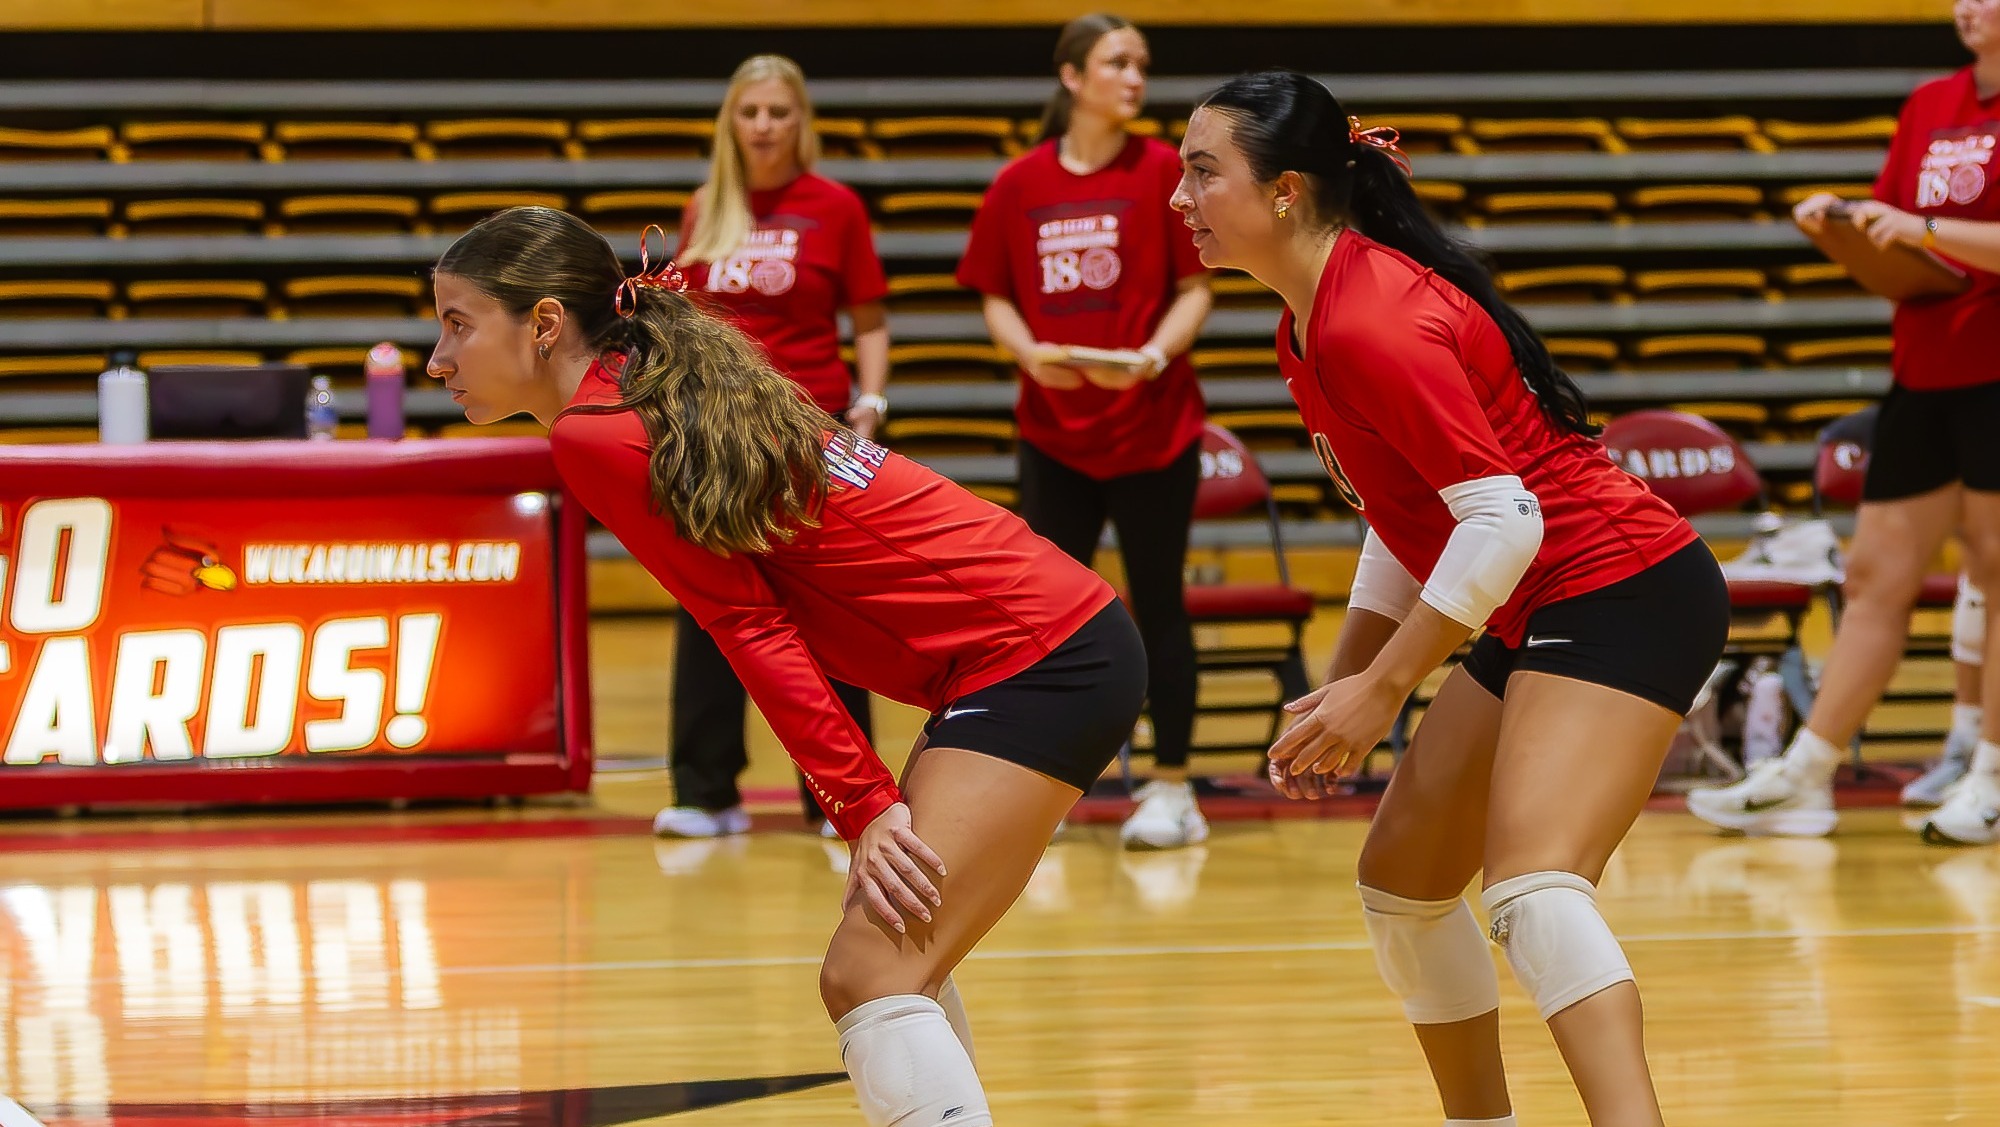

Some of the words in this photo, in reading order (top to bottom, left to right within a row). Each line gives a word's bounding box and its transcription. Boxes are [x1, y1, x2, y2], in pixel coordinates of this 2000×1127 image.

[0, 497, 112, 634] O
[245, 542, 521, 584] WUCARDINALS.COM
[0, 613, 441, 765] ARDS!
